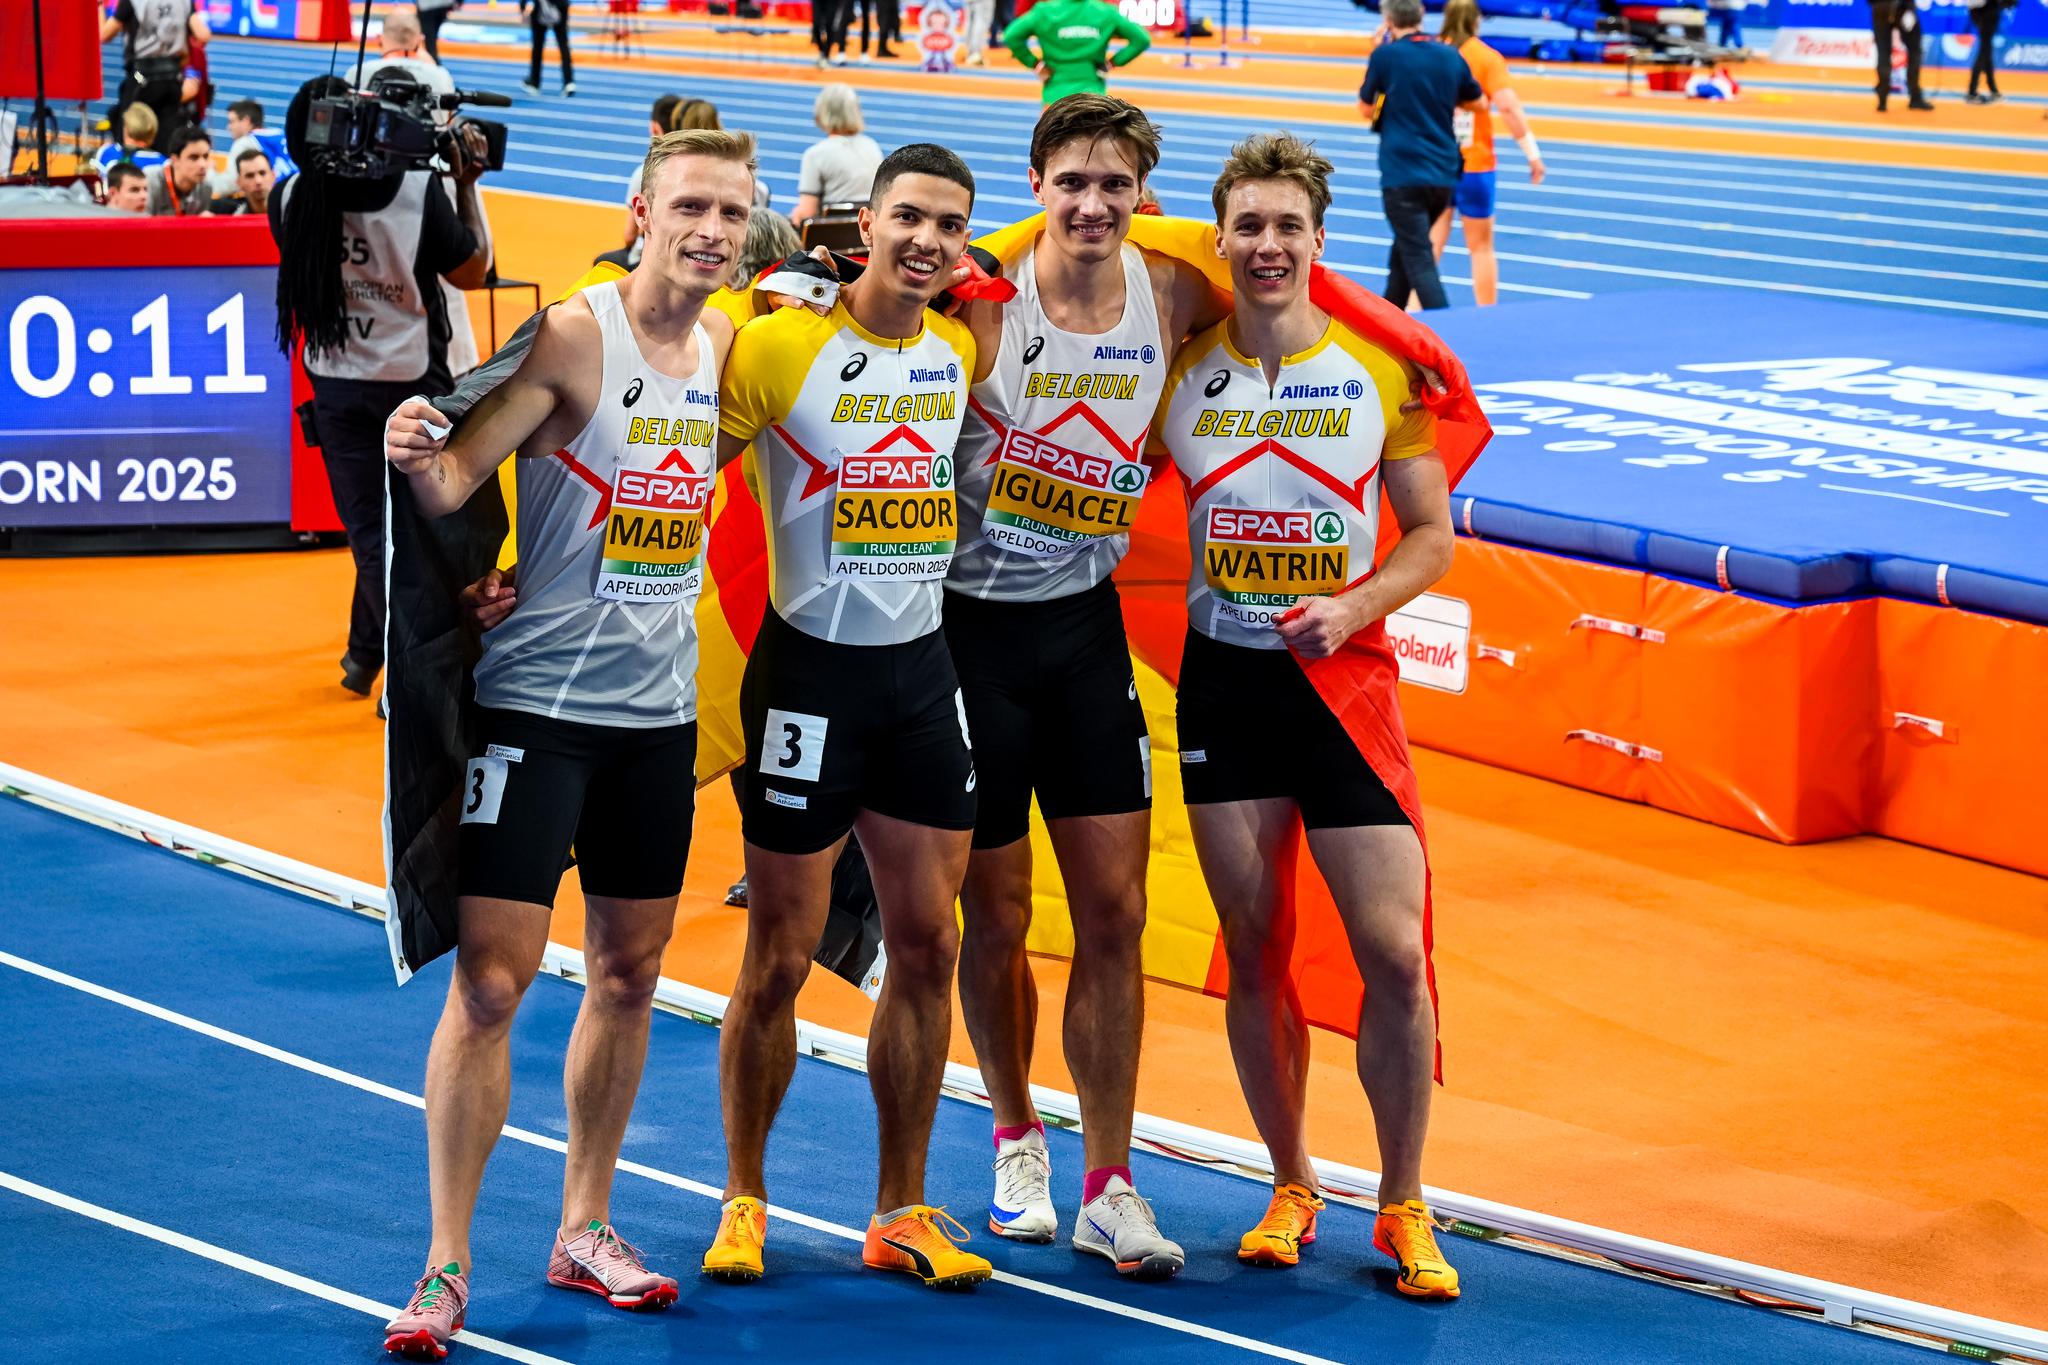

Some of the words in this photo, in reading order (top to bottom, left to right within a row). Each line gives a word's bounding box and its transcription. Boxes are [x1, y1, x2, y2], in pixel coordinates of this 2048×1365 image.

[343, 281, 404, 293] UROPEAN
[9, 292, 267, 398] 0:11
[1093, 346, 1138, 361] Allianz
[909, 368, 946, 384] Allianz
[1025, 372, 1139, 400] BELGIUM
[1280, 384, 1340, 399] Allianz
[831, 391, 956, 423] BELGIUM
[627, 416, 716, 448] BELGIUM
[1191, 407, 1352, 438] BELGIUM
[844, 460, 930, 485] SPAR
[1009, 434, 1107, 484] SPAR
[0, 460, 101, 504] ORN
[117, 456, 237, 501] 2025
[995, 468, 1131, 527] IGUACEL
[836, 498, 954, 530] SACOOR
[1014, 515, 1020, 526] I
[1021, 517, 1050, 535] RUN
[1212, 511, 1310, 540] SPAR
[863, 542, 868, 555] I
[869, 542, 899, 555] RUN
[632, 562, 638, 574] I
[639, 563, 665, 575] RUN
[836, 560, 925, 576] APELDOORN
[927, 559, 949, 573] 2025
[1207, 548, 1343, 581] WATRIN
[1233, 592, 1238, 602] I
[1240, 592, 1268, 605] RUN
[779, 723, 802, 768] 3
[467, 768, 485, 814] 3
[776, 798, 806, 808] Athletics
